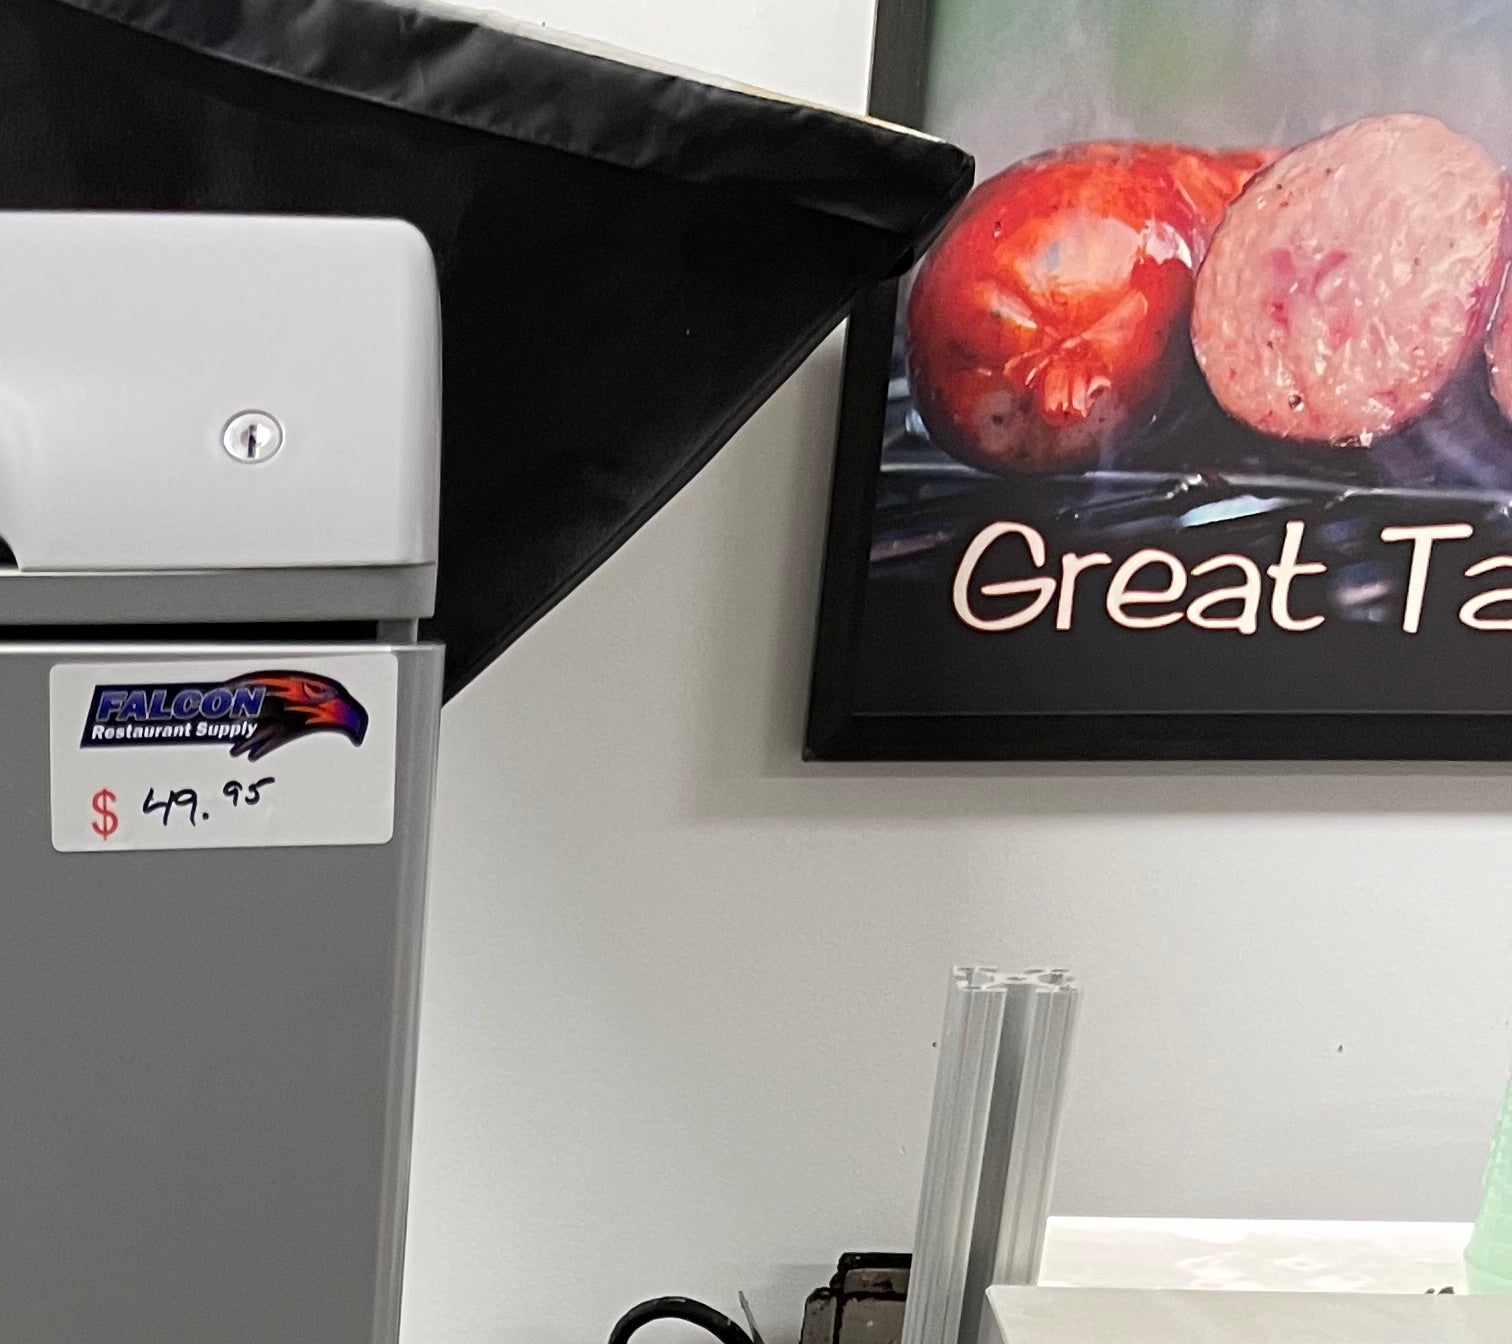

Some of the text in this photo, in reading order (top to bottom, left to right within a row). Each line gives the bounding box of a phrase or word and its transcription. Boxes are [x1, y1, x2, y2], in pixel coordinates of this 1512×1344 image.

[952, 520, 1327, 635] Great
[97, 687, 266, 721] FALCON
[91, 721, 258, 740] Restaurant Supply
